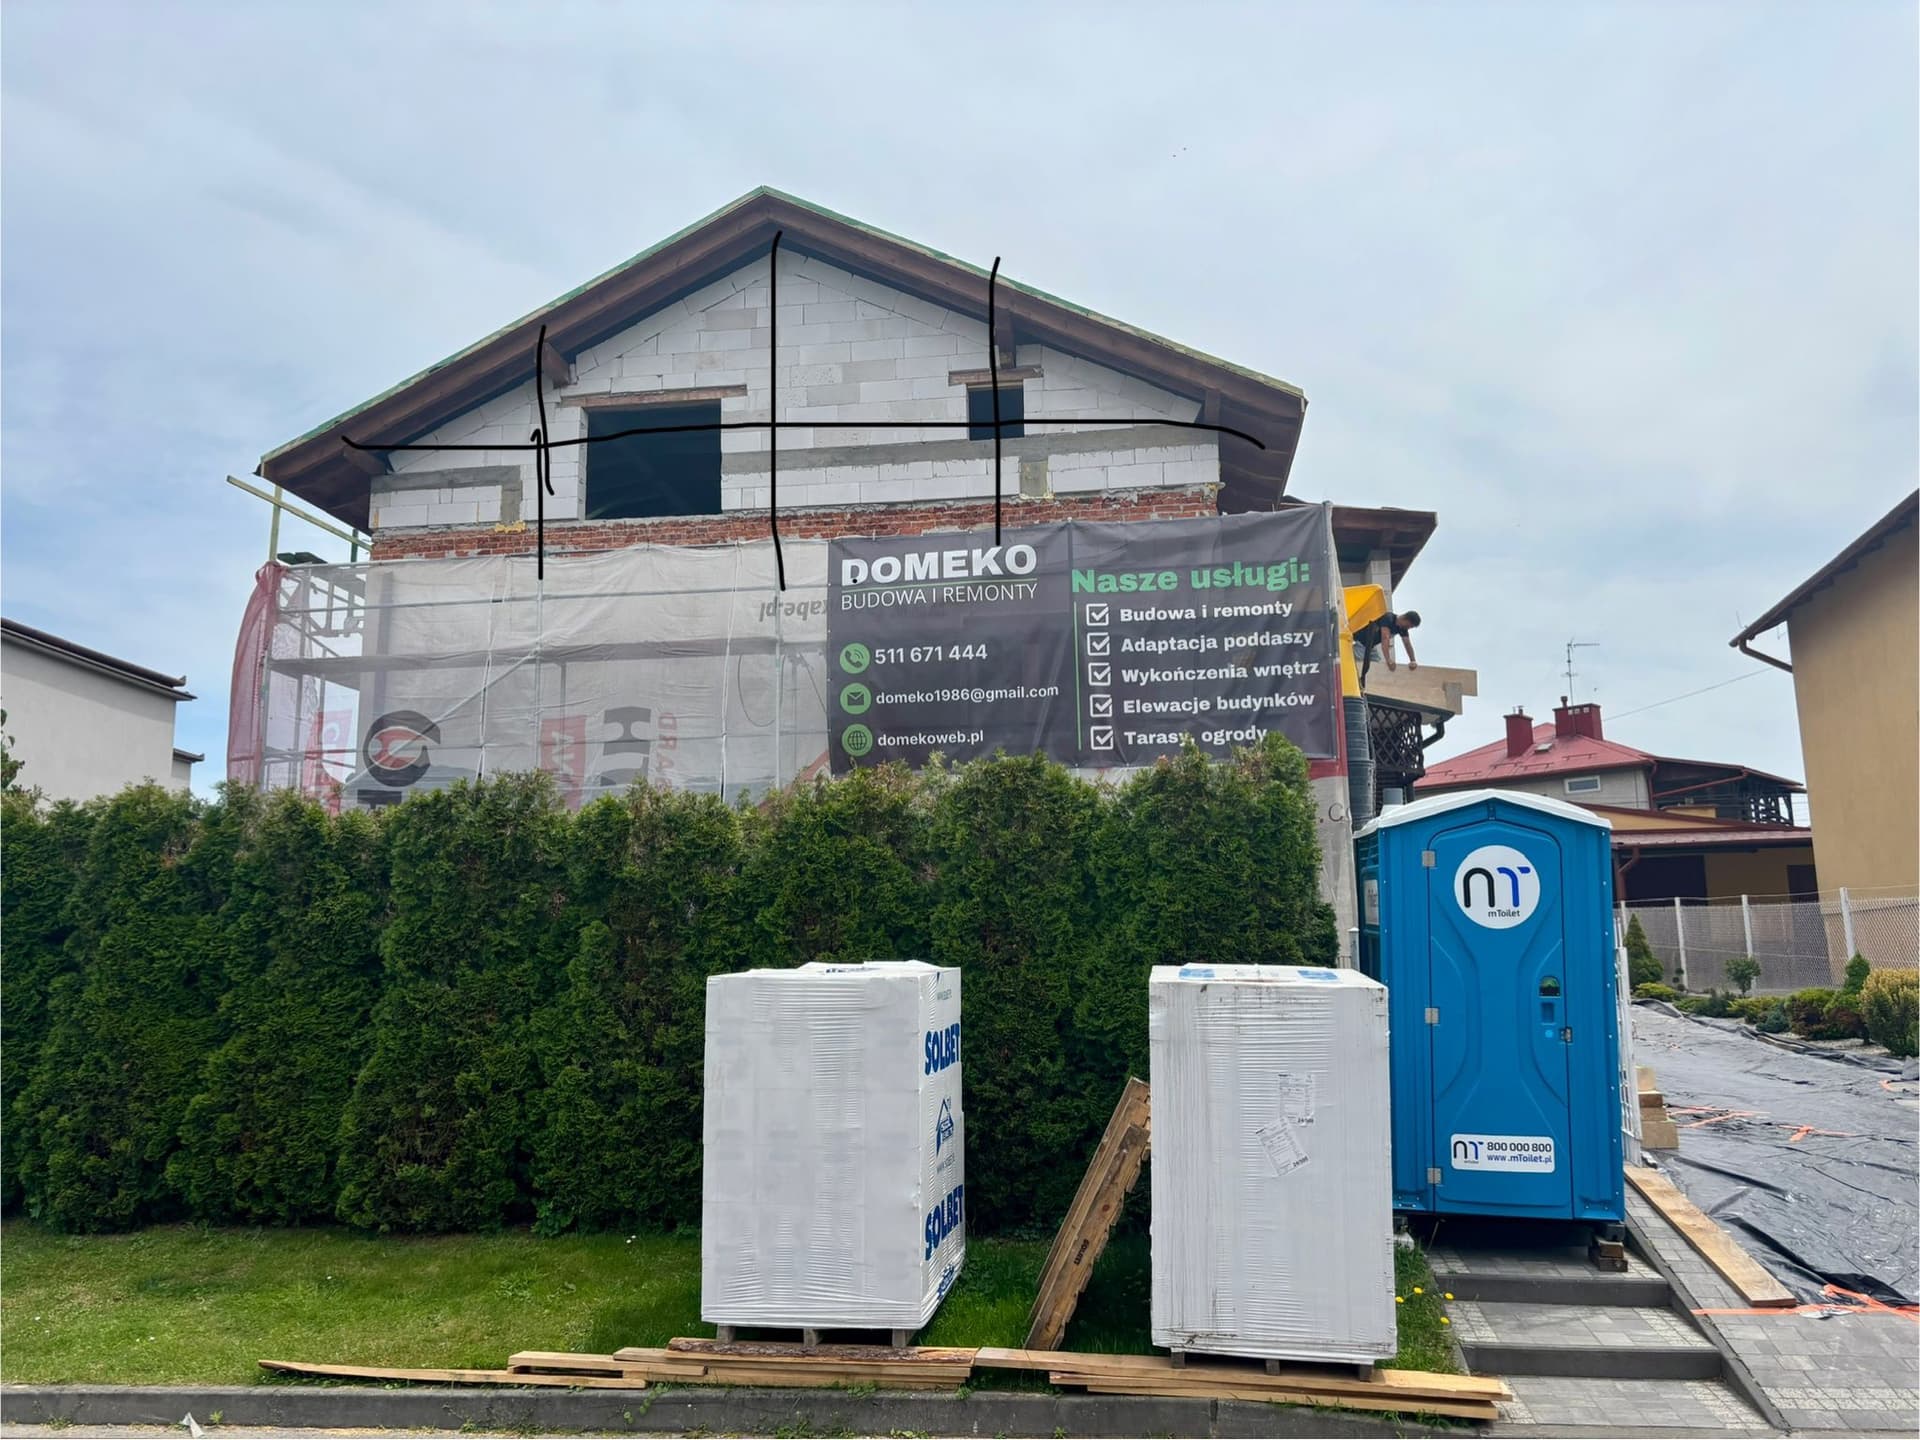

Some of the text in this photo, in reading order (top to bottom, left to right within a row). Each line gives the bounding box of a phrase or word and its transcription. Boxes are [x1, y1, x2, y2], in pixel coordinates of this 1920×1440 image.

[842, 544, 1037, 586] DOMEKO
[1072, 557, 1310, 593] Nasze usługi:
[841, 583, 1038, 611] BUDOWA I REMONTY
[1120, 600, 1293, 622] Budowa i remonty
[1121, 631, 1314, 653] Adaptacja poddaszy
[874, 644, 988, 664] 511 671 444
[1121, 660, 1320, 686] Wykończenia wnętrz
[876, 685, 1059, 705] domeko1986@gmail.com
[1123, 692, 1315, 715] Elewacje budynków
[877, 730, 984, 747] domekoweb.pl
[1123, 725, 1267, 747] Tarasy, ogrody
[1488, 909, 1520, 917] mToilet
[925, 1022, 960, 1076] SOLBET
[1487, 1141, 1508, 1151] 800
[1509, 1142, 1530, 1152] 000
[1531, 1143, 1552, 1153] 800
[925, 1184, 963, 1261] SOLBET
